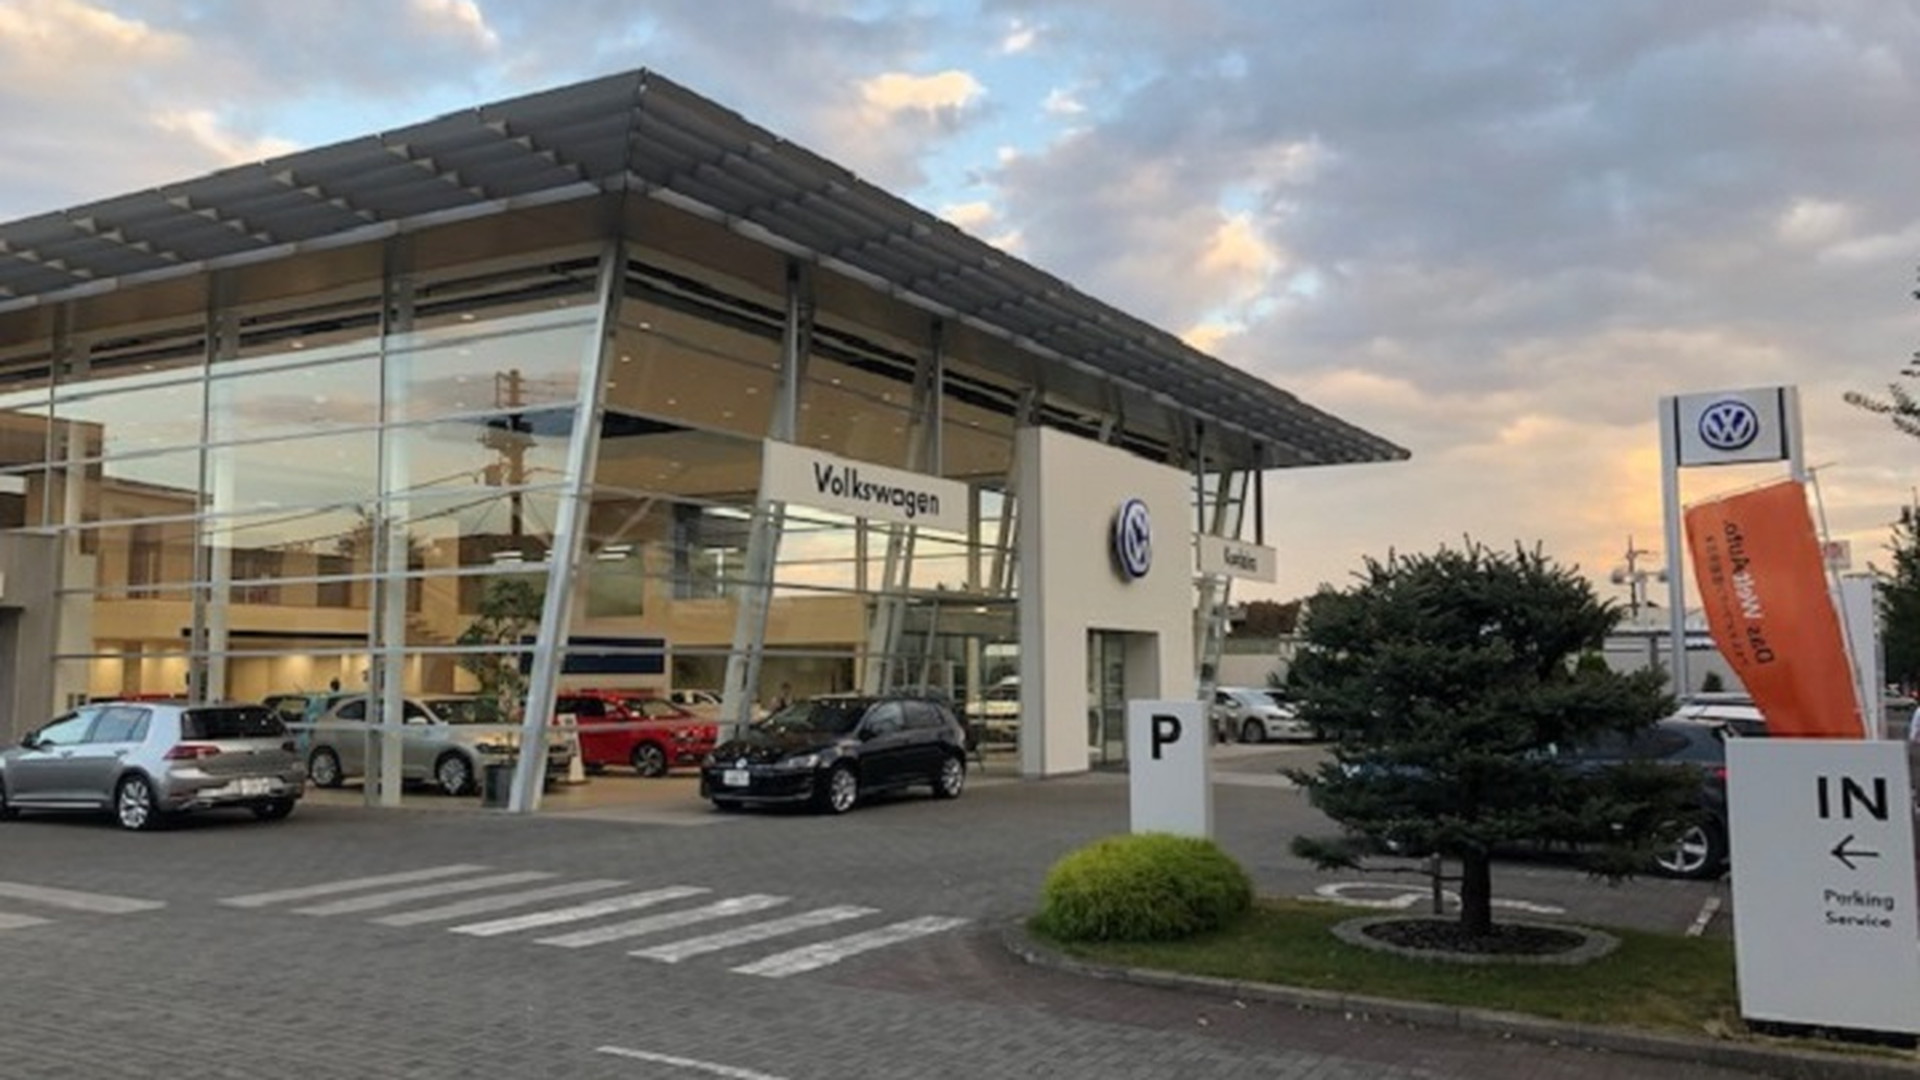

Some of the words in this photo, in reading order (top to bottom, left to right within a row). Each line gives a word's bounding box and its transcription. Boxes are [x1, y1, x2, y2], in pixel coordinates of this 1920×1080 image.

[813, 461, 940, 518] Volkswagen
[1152, 714, 1182, 760] P
[1817, 775, 1888, 821] IN
[1824, 889, 1895, 911] Parking
[1825, 911, 1892, 928] Service
